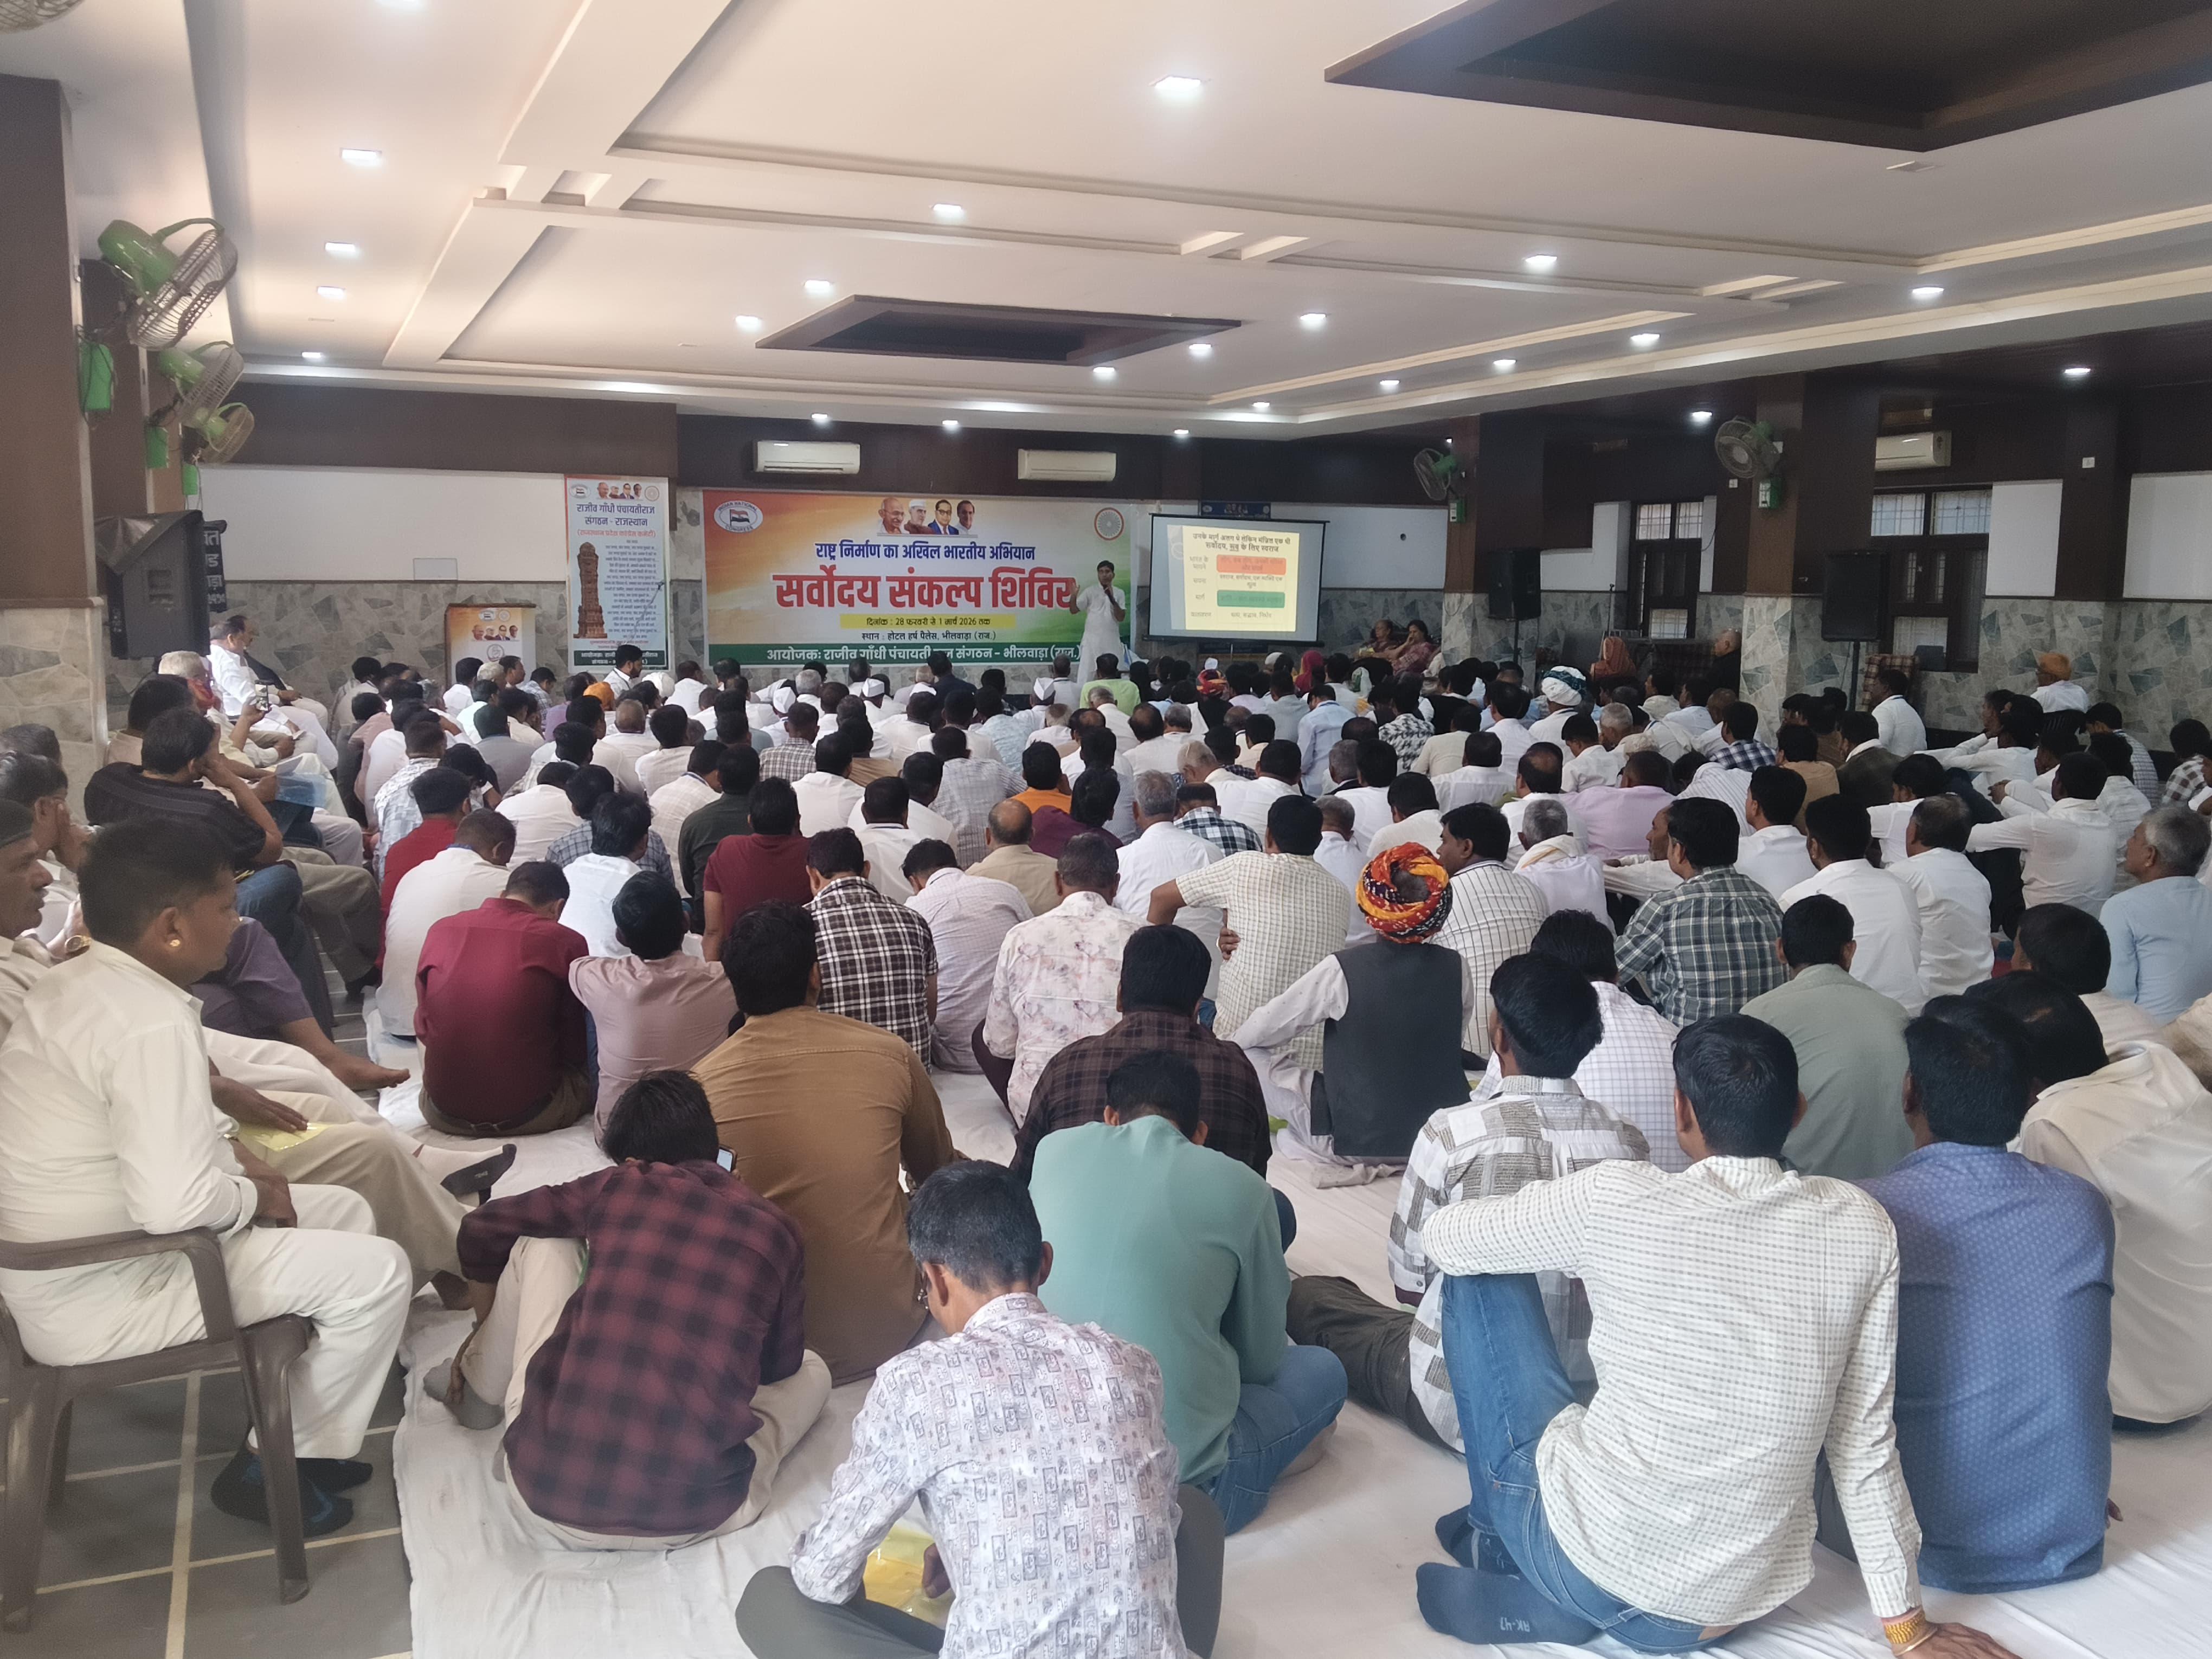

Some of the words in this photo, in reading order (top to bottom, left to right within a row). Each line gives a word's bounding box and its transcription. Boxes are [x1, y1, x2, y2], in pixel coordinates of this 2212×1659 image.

[576, 502, 597, 512] राजीव
[616, 503, 655, 514] पंचायतीराज
[584, 515, 608, 525] संगठन
[614, 517, 648, 526] राजस्थान
[815, 543, 837, 561] राष्ट्र
[839, 539, 881, 558] निर्माण
[883, 544, 899, 558] का
[902, 541, 941, 560] अखिल
[943, 541, 986, 560] भारतीय
[989, 542, 1035, 561] अभियान
[773, 564, 881, 608] सर्वोदय
[885, 566, 984, 608] संकल्प
[988, 566, 1075, 608] शिविर
[867, 617, 888, 626] दिनांक
[906, 618, 928, 626] फरवरी
[944, 617, 957, 625] मार्च
[861, 632, 879, 640] स्थान
[888, 631, 905, 640] होटल
[908, 631, 917, 640] हर्ष
[920, 631, 939, 641] पैलेस,
[942, 631, 972, 641] भीलवाड़ा
[974, 631, 996, 640] (राज.)
[824, 645, 858, 660] राजीव
[859, 645, 887, 660] गाँधी
[888, 645, 931, 660] पंचायती
[956, 645, 993, 659] संगठन
[1003, 645, 1050, 661] भीलवाड़ा
